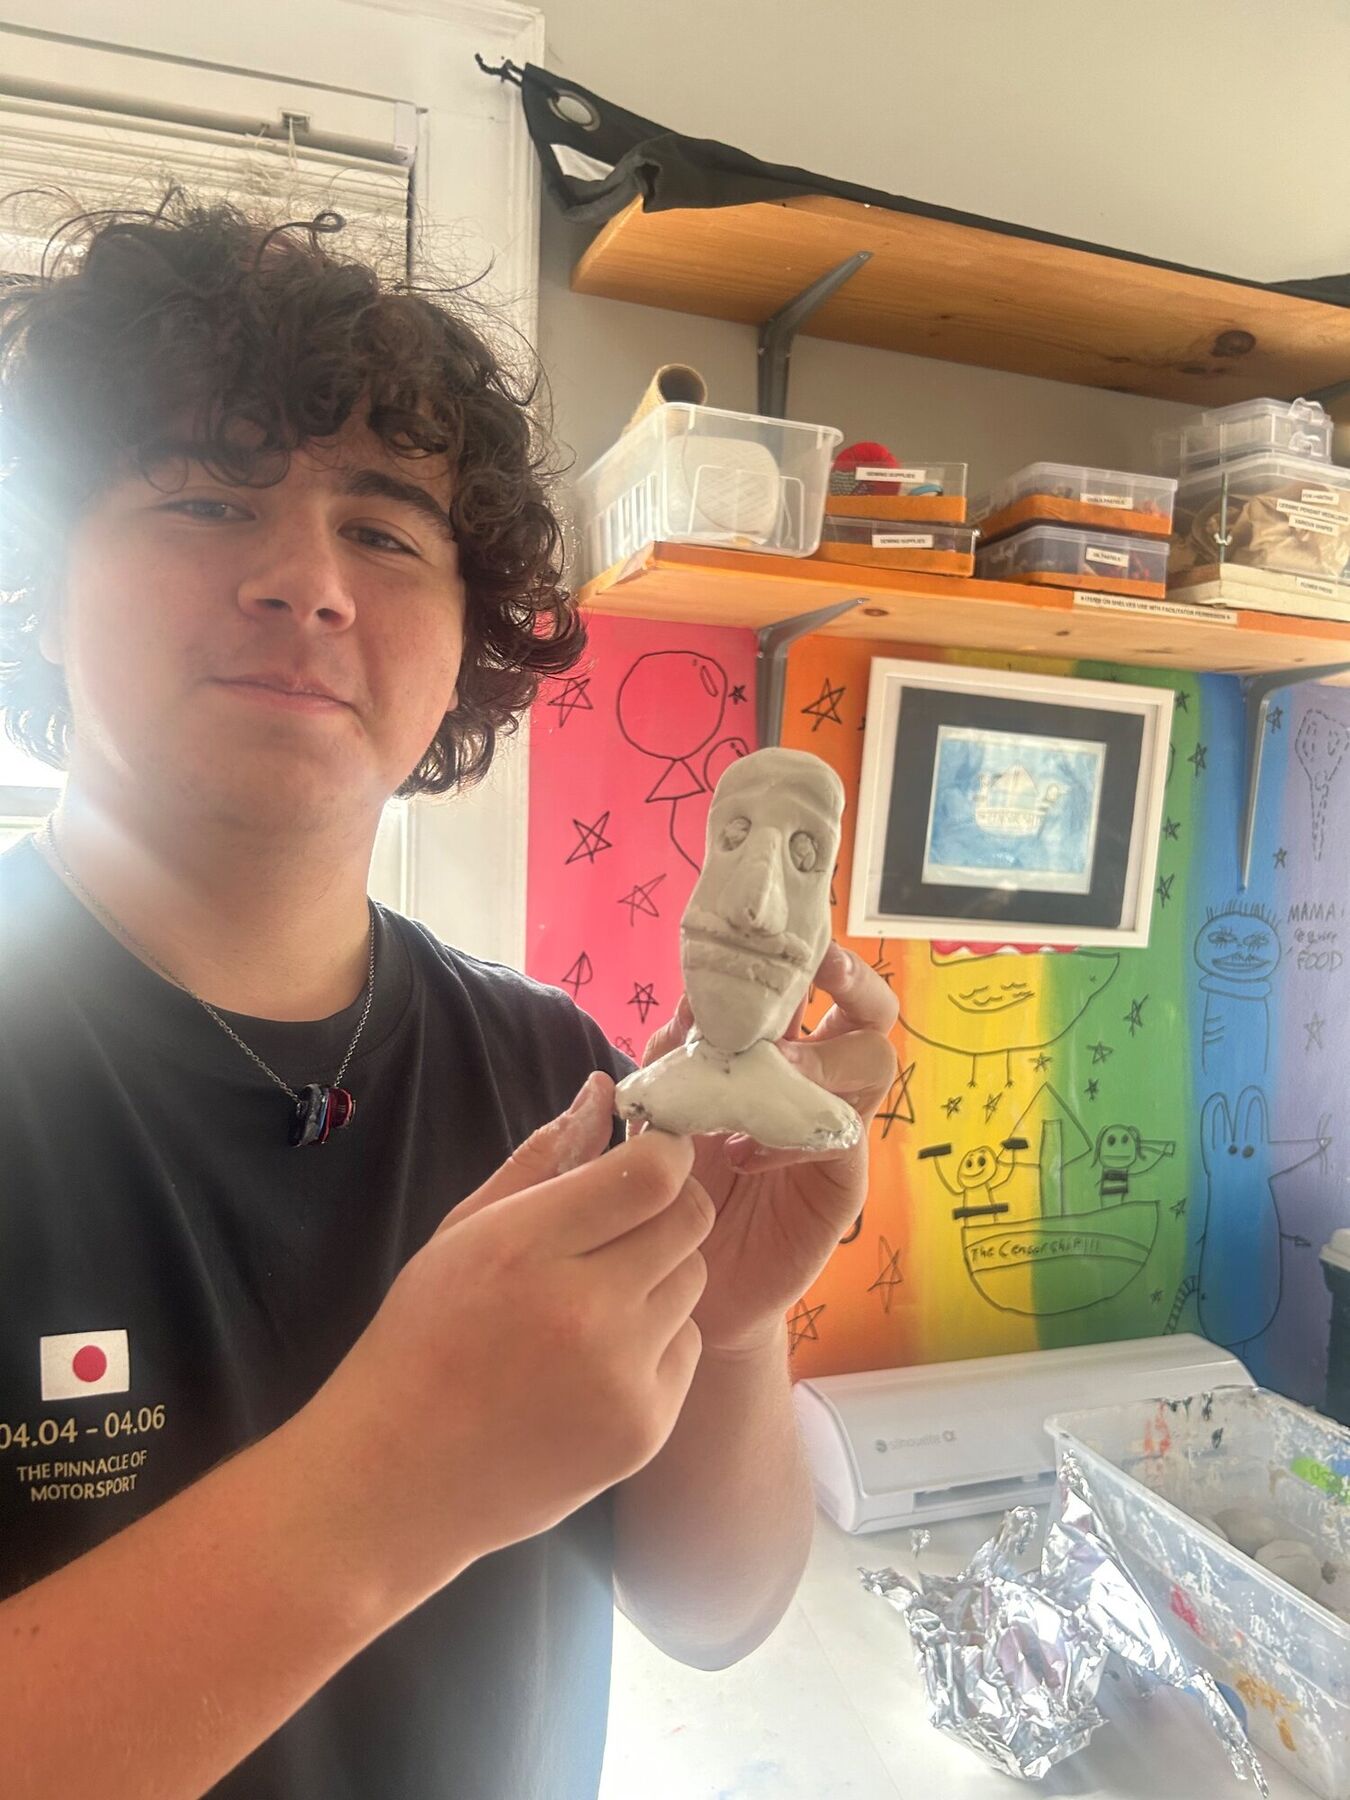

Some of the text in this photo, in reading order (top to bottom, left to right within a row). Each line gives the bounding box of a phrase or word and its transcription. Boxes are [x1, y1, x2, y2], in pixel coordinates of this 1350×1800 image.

[1112, 600, 1136, 608] SHELVES
[1287, 901, 1336, 924] MAMA
[1297, 949, 1343, 971] FOOD
[0, 1417, 78, 1449] 04.04
[104, 1404, 166, 1438] 04.06
[17, 1449, 147, 1482] THE PINNACLE OF
[30, 1474, 137, 1501] MOTORSPORT
